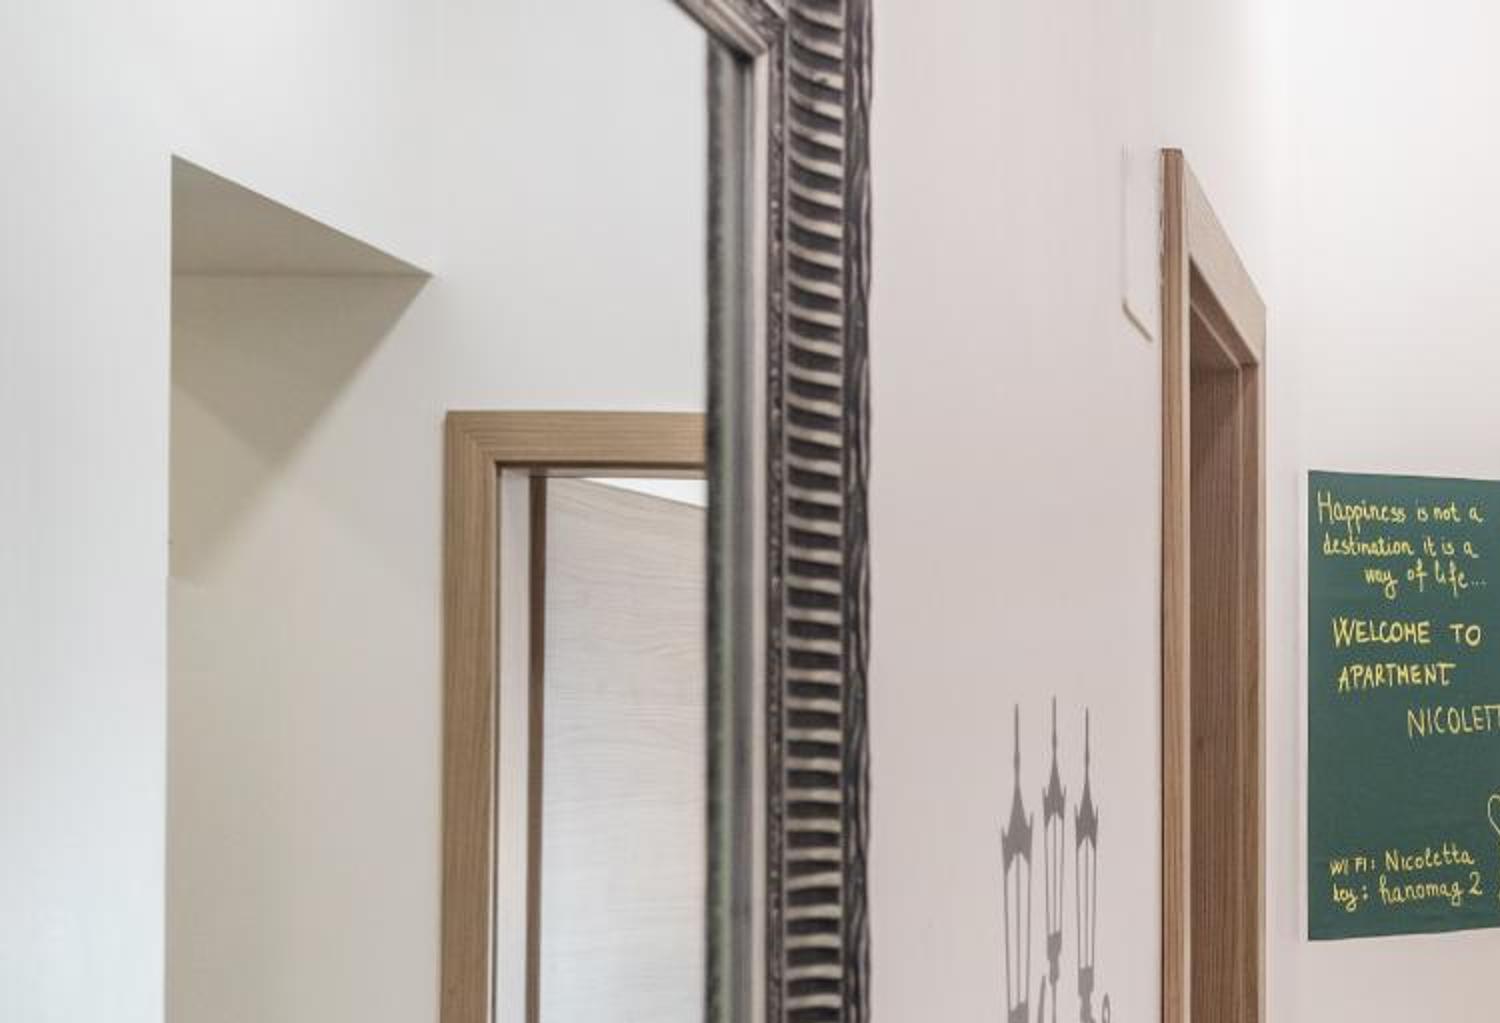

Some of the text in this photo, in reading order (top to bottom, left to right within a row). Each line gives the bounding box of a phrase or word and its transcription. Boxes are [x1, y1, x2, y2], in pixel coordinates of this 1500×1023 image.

[1316, 490, 1485, 534] Happiness is not a
[1322, 532, 1480, 559] destination it is a
[1363, 566, 1399, 600] way
[1407, 557, 1428, 593] of
[1331, 615, 1482, 648] WELCOME TO
[1337, 661, 1457, 693] APARTMENT
[1385, 842, 1476, 872] Nicoletta
